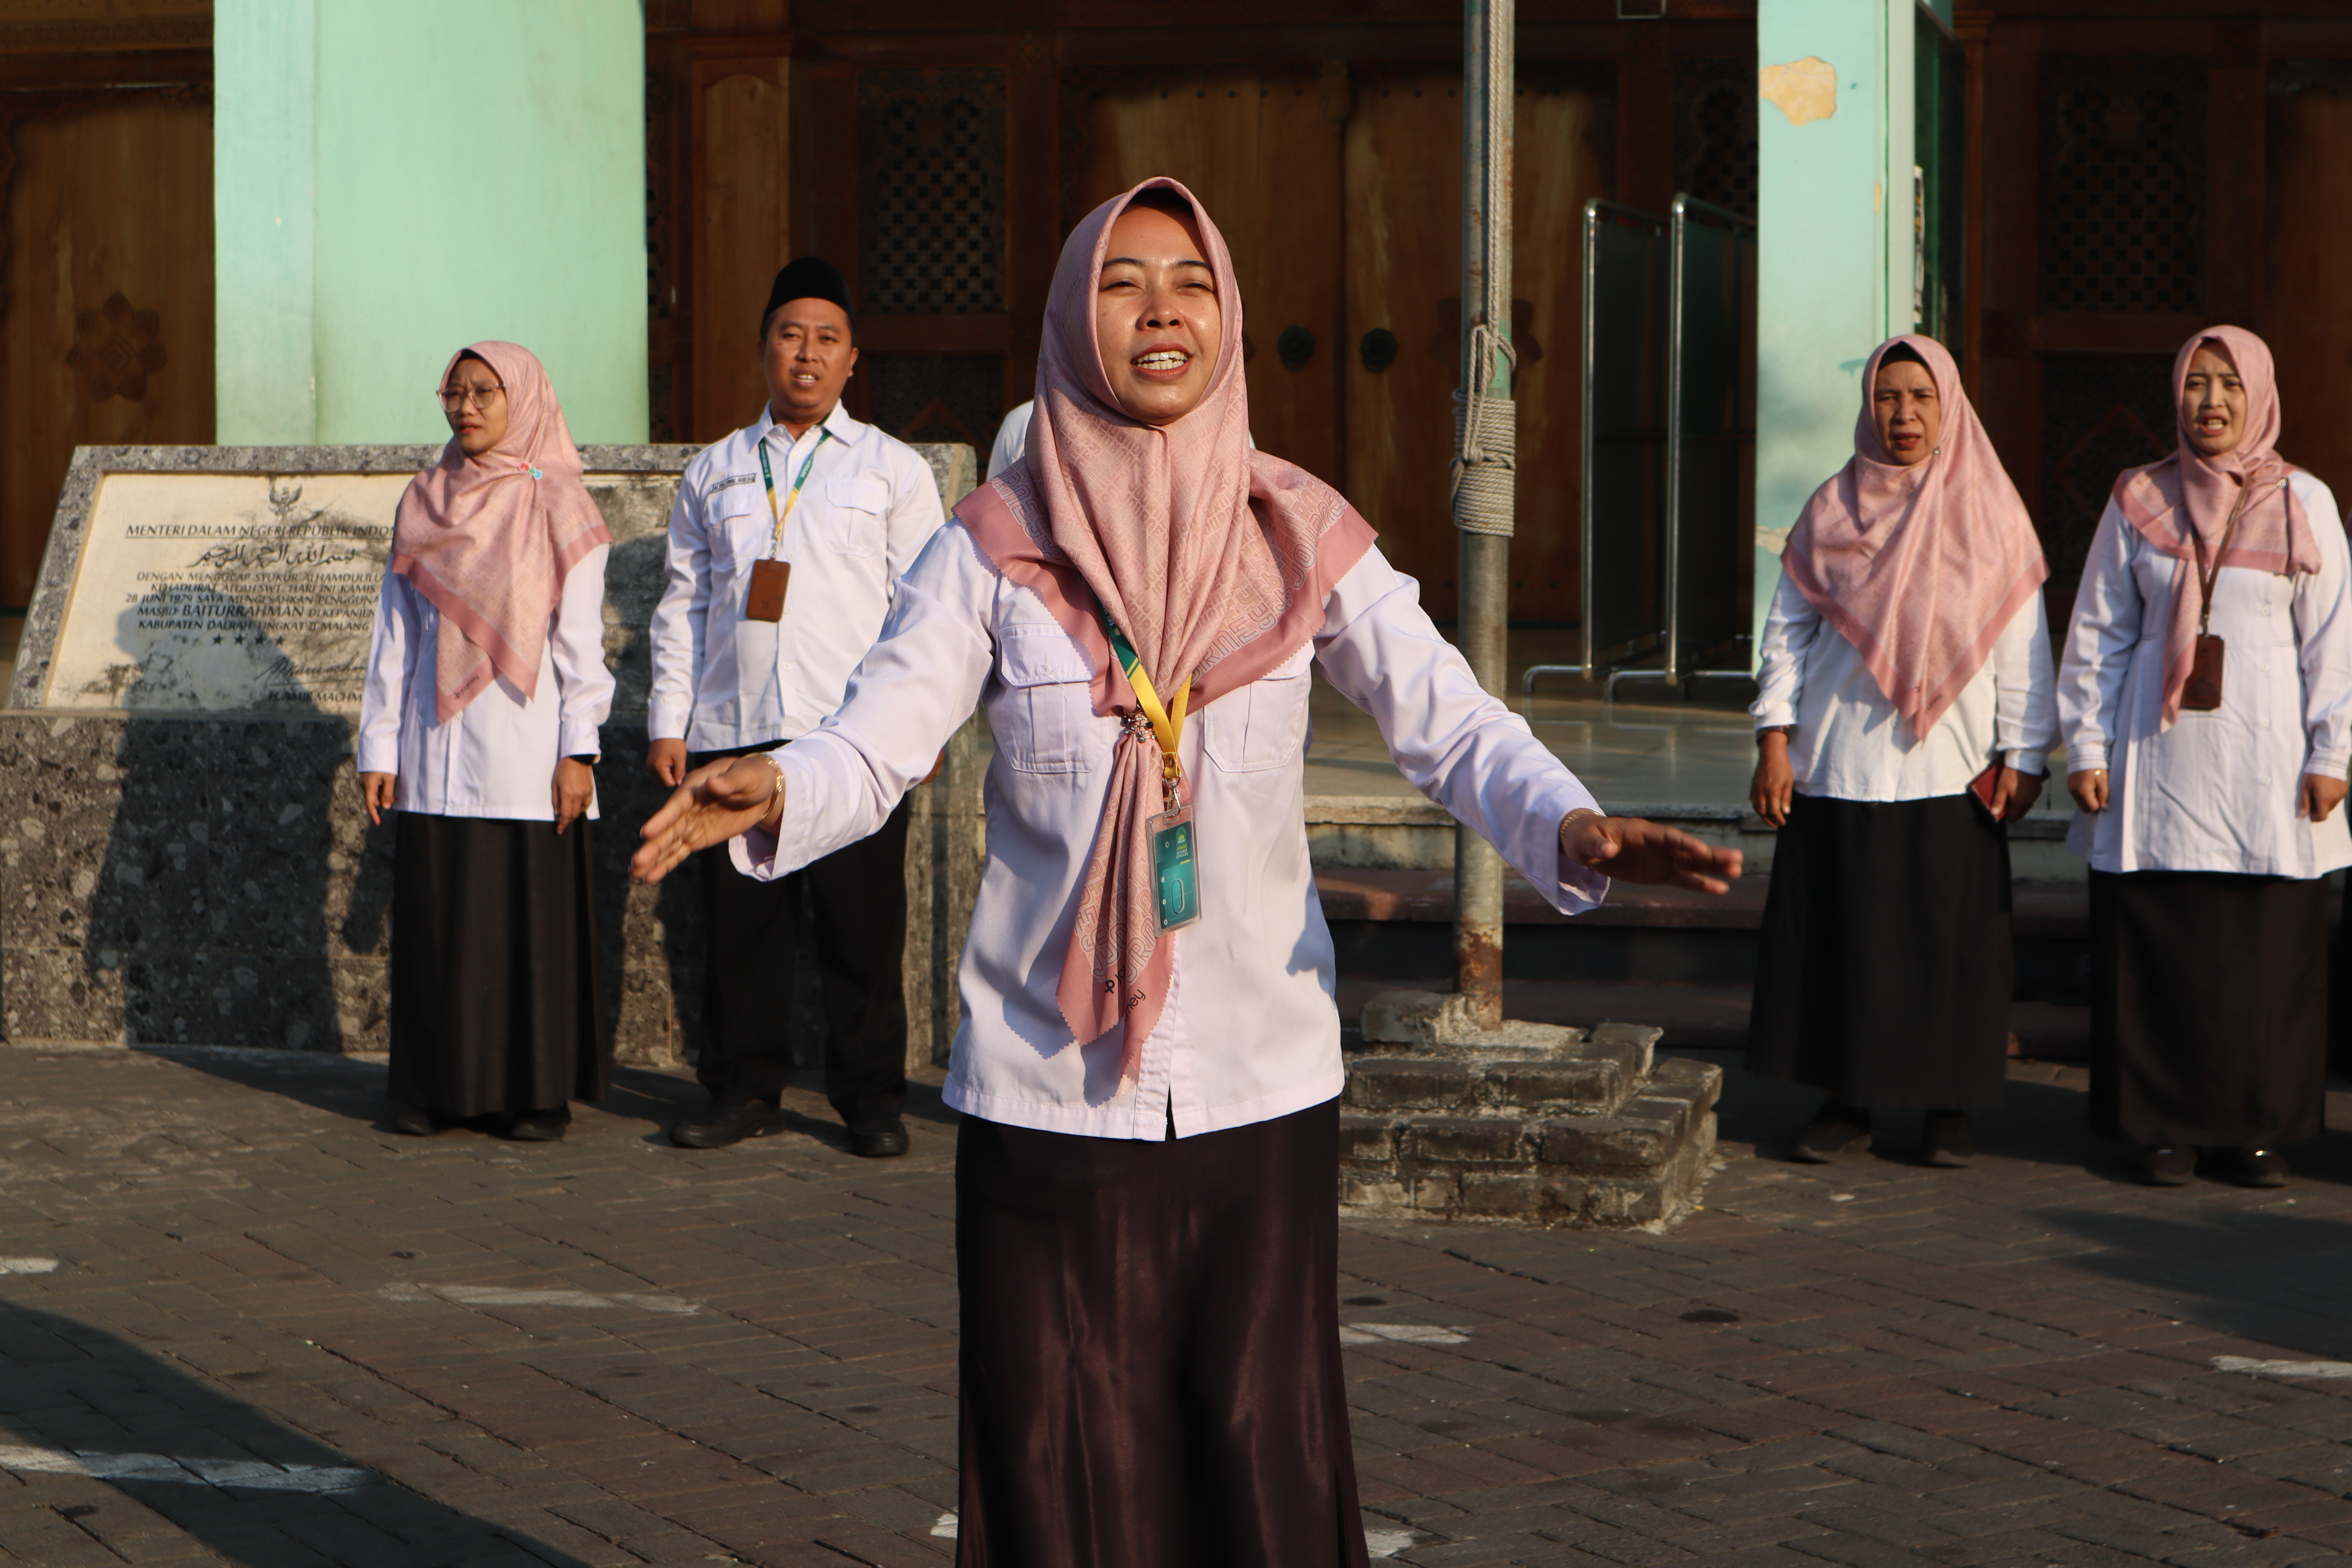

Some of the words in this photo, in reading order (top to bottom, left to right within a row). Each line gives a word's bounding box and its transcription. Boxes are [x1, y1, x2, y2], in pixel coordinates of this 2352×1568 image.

[126, 524, 185, 536] MENTERI
[188, 524, 236, 536] DALAM
[240, 525, 286, 537] NEGERI
[289, 525, 348, 538] REPUBLIK
[137, 572, 185, 581] DENGAN
[255, 573, 298, 583] SYUKUR
[290, 584, 315, 593] HARI
[320, 584, 336, 593] INI
[340, 584, 376, 593] KAMIS
[125, 593, 138, 603] 28
[141, 593, 167, 605] JUNI
[170, 594, 193, 603] 1979
[197, 594, 223, 604] SAYA
[229, 594, 314, 605] MENGESAHKAN
[182, 604, 305, 617] BAITURRAHMAN
[308, 608, 320, 617] DI
[322, 608, 375, 619] KEPANJEN
[138, 619, 204, 630] KABUPATEN
[207, 619, 252, 630] DAERAH
[256, 620, 304, 631] TINGKAT
[320, 621, 370, 631] MALANG
